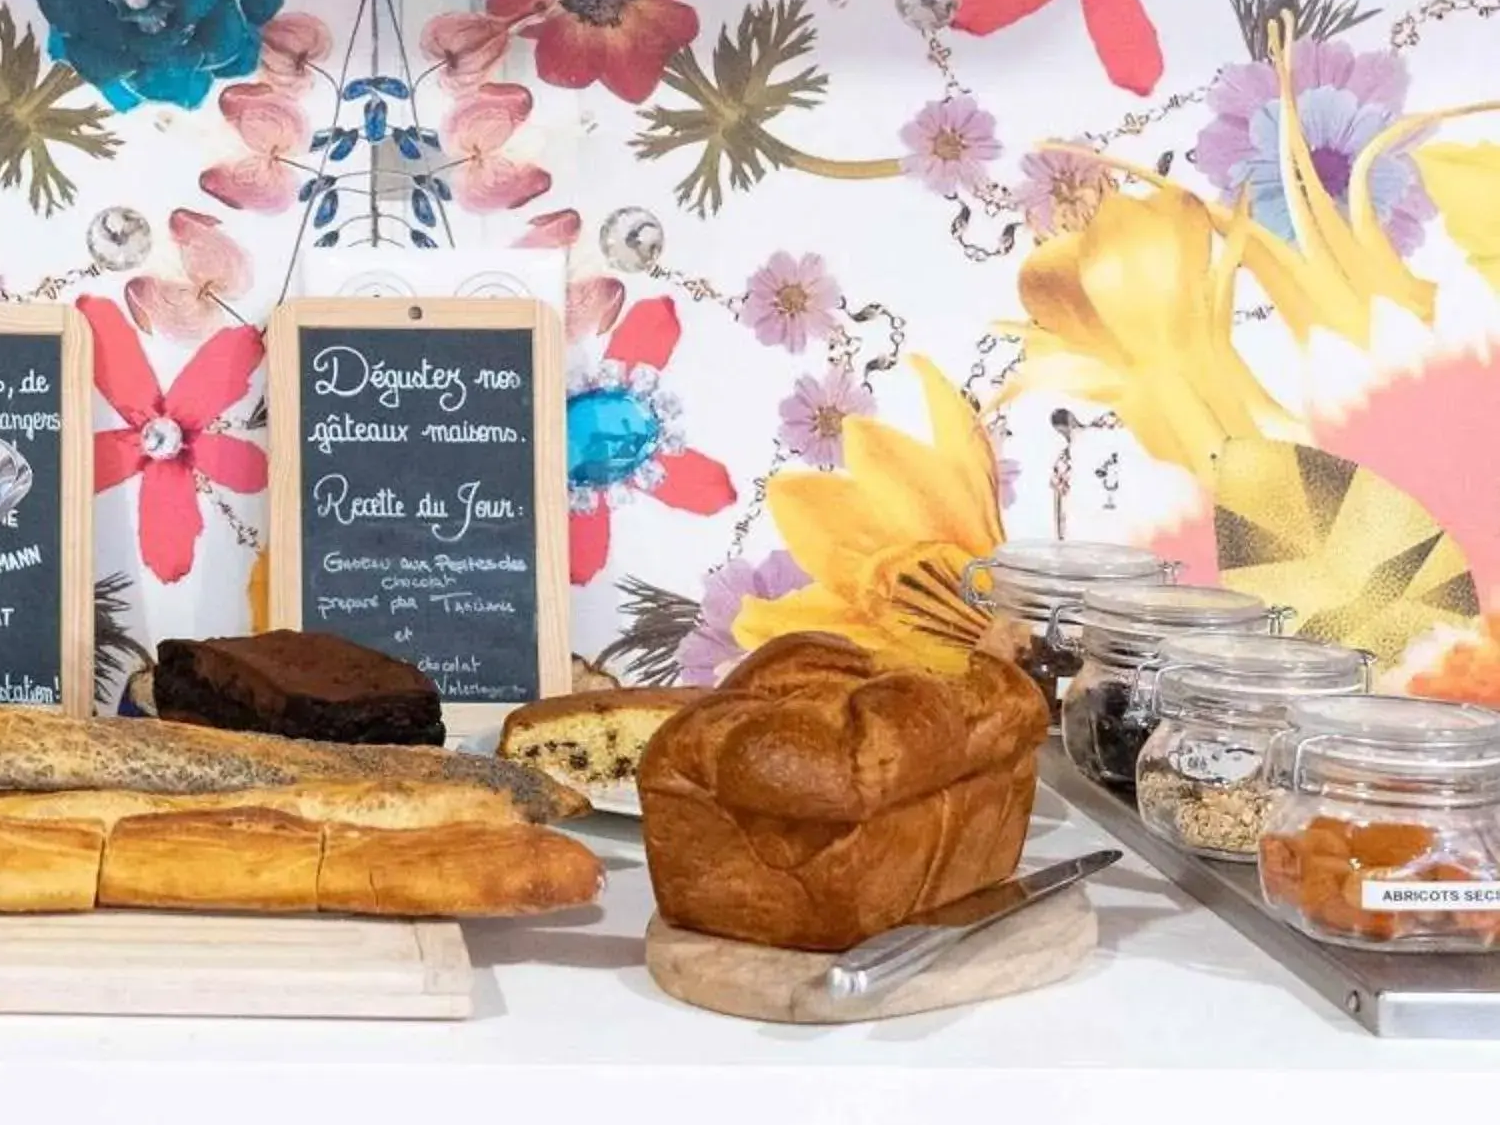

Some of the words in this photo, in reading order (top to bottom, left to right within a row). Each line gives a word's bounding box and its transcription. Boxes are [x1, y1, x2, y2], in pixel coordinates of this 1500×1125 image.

[18, 368, 51, 394] de
[313, 345, 467, 412] Dégustez
[473, 369, 522, 390] nos
[307, 412, 409, 455] gâteaux
[313, 473, 407, 525] Recette
[416, 491, 449, 519] du
[1381, 889, 1460, 903] ABRICOTS
